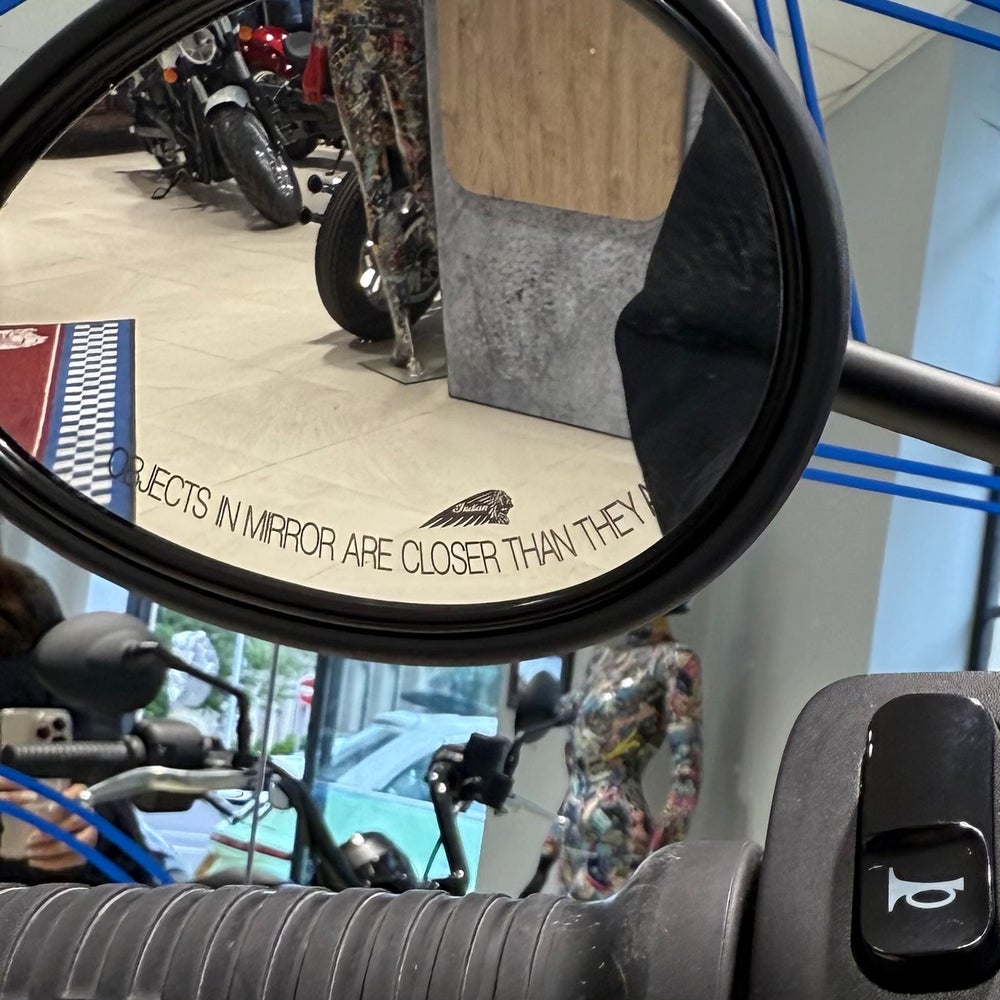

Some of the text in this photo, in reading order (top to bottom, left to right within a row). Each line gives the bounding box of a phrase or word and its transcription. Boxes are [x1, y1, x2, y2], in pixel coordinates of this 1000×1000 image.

[109, 447, 211, 519] OBJECTS
[216, 495, 241, 532] IN
[243, 505, 336, 561] MIRROR
[341, 533, 393, 571] ARE
[401, 540, 501, 575] CLOSER
[502, 524, 577, 571] THAN
[572, 491, 645, 550] THEY
[452, 502, 488, 513] Indian
